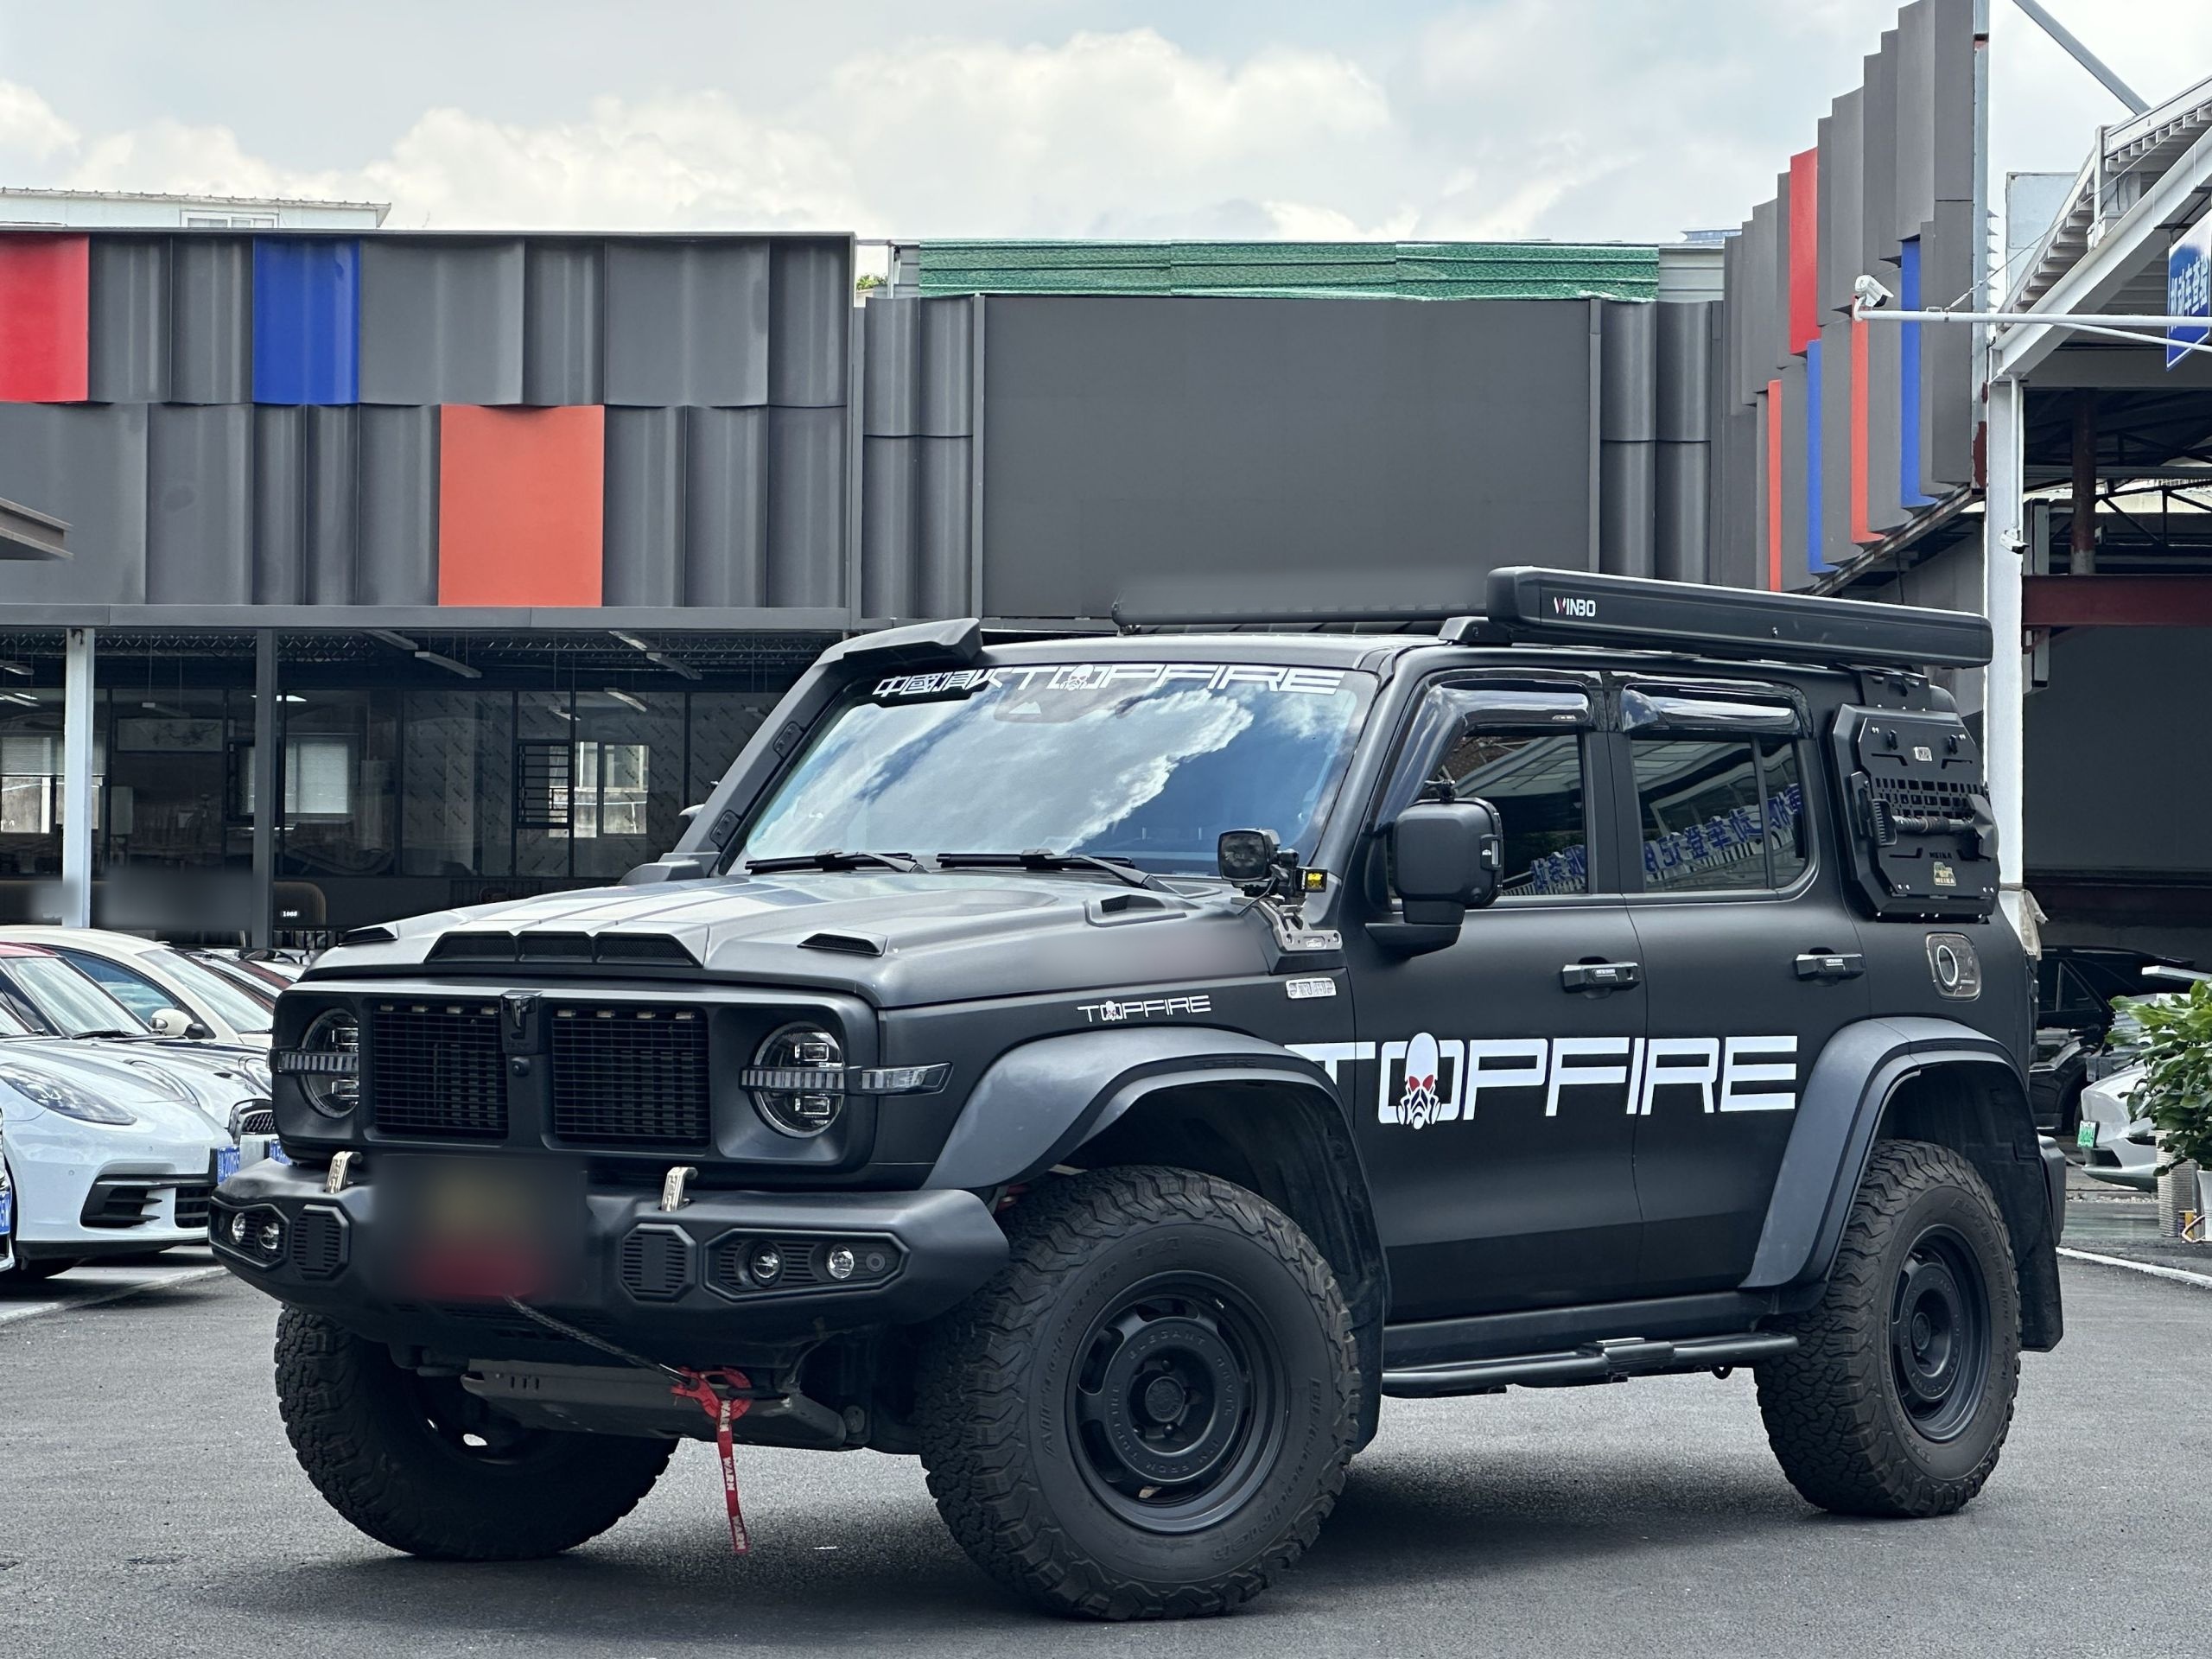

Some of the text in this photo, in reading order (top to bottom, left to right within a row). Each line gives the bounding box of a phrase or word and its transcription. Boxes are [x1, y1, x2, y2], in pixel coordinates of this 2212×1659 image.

[1554, 596, 1596, 617] WINBO
[1010, 663, 1346, 695] TOPFIRE
[1077, 995, 1211, 1022] TOPFIRE
[1285, 1033, 1798, 1129] TOPFIRE
[720, 1400, 731, 1432] WARN
[722, 1456, 735, 1491] WARN
[732, 1515, 747, 1550] WARN
